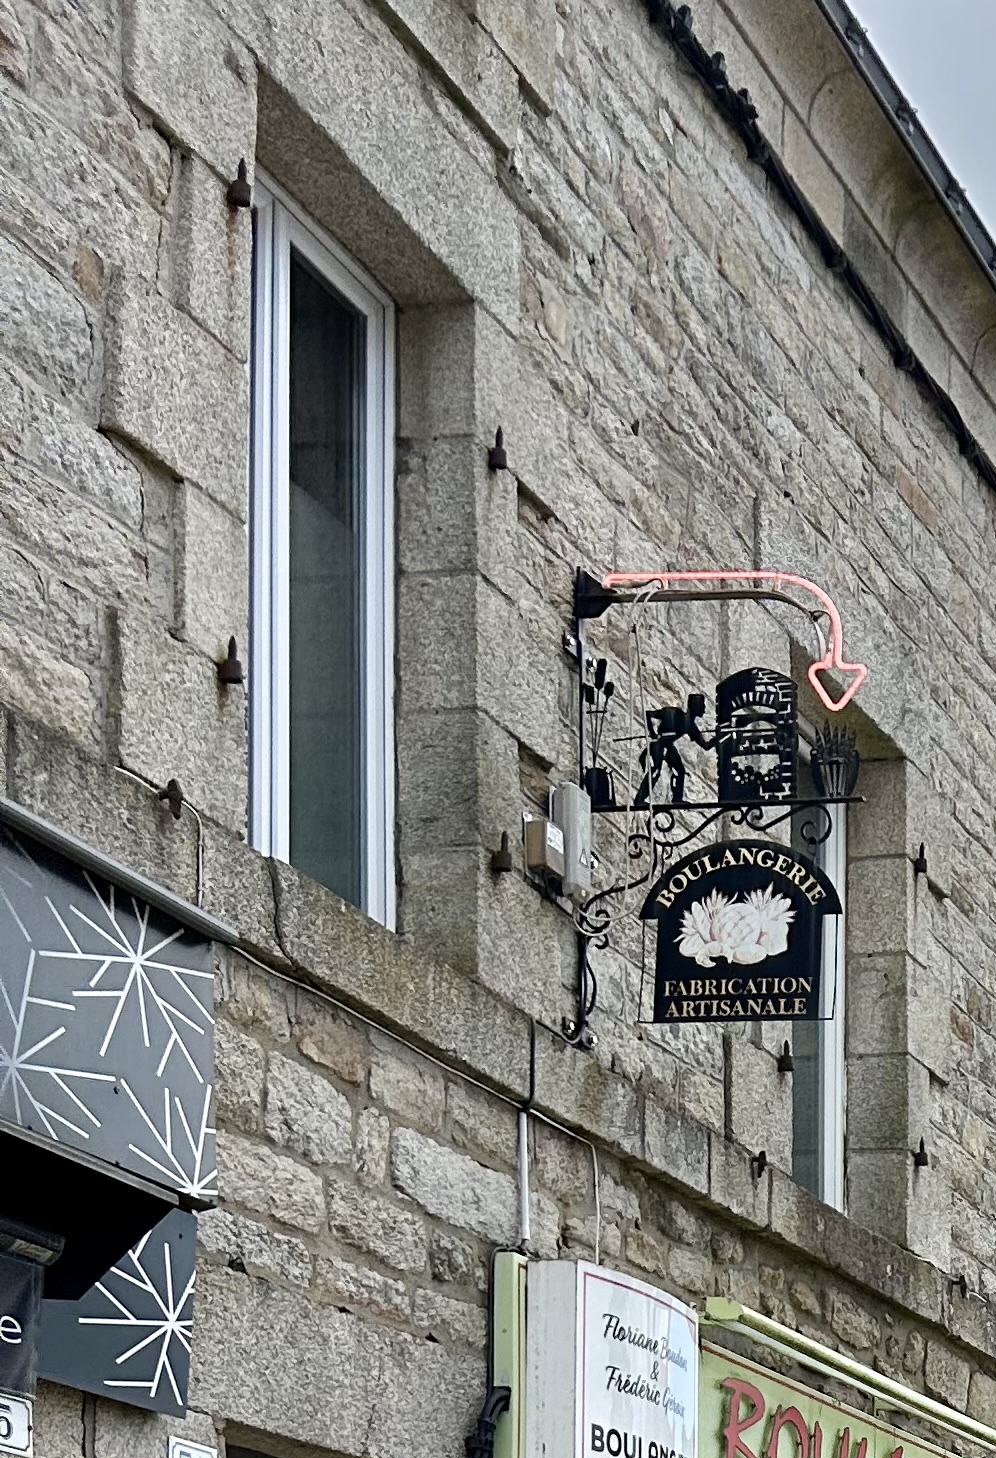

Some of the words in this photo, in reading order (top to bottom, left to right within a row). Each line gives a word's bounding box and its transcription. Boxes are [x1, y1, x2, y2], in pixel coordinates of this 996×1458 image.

[656, 847, 828, 909] BOULANGERIE
[663, 976, 814, 997] FABRICATION
[665, 998, 808, 1018] ARTISANALE
[602, 1313, 659, 1355] Floriane
[605, 1365, 661, 1406] Frédéric
[650, 1360, 660, 1381] &
